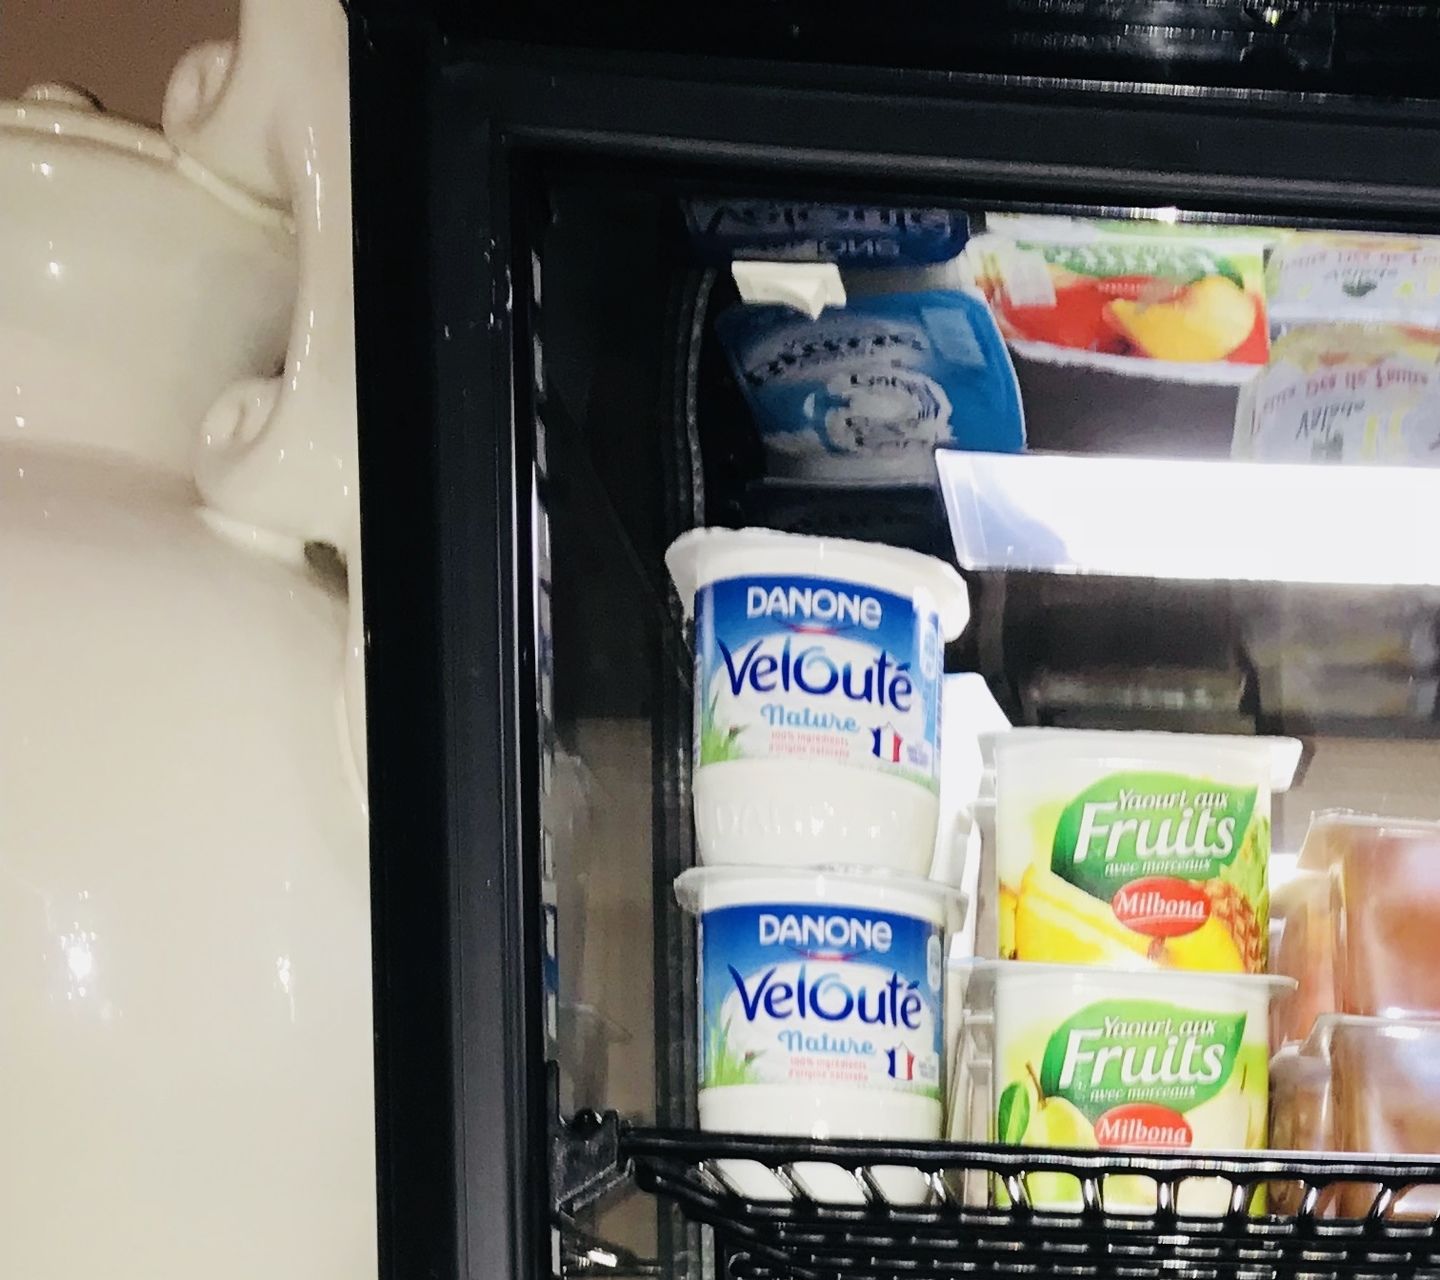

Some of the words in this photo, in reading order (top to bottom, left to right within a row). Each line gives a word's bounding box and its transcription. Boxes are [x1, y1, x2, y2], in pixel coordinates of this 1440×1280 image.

[747, 586, 882, 630] DANONE
[716, 636, 913, 713] Velouté
[759, 703, 860, 732] Nature
[1119, 788, 1187, 810] Yaourt
[1194, 790, 1230, 810] aux
[1073, 801, 1236, 863] Fruits
[1105, 863, 1138, 877] avec
[1117, 891, 1205, 919] Milbona
[759, 913, 893, 954] DANONE
[727, 963, 923, 1031] Velouté
[1104, 1015, 1172, 1037] Yaourt
[1179, 1018, 1217, 1036] aux
[777, 1028, 878, 1056] Nature
[1058, 1027, 1226, 1090] Fruits
[1090, 1088, 1124, 1103] avec
[1099, 1117, 1188, 1145] Milbona
